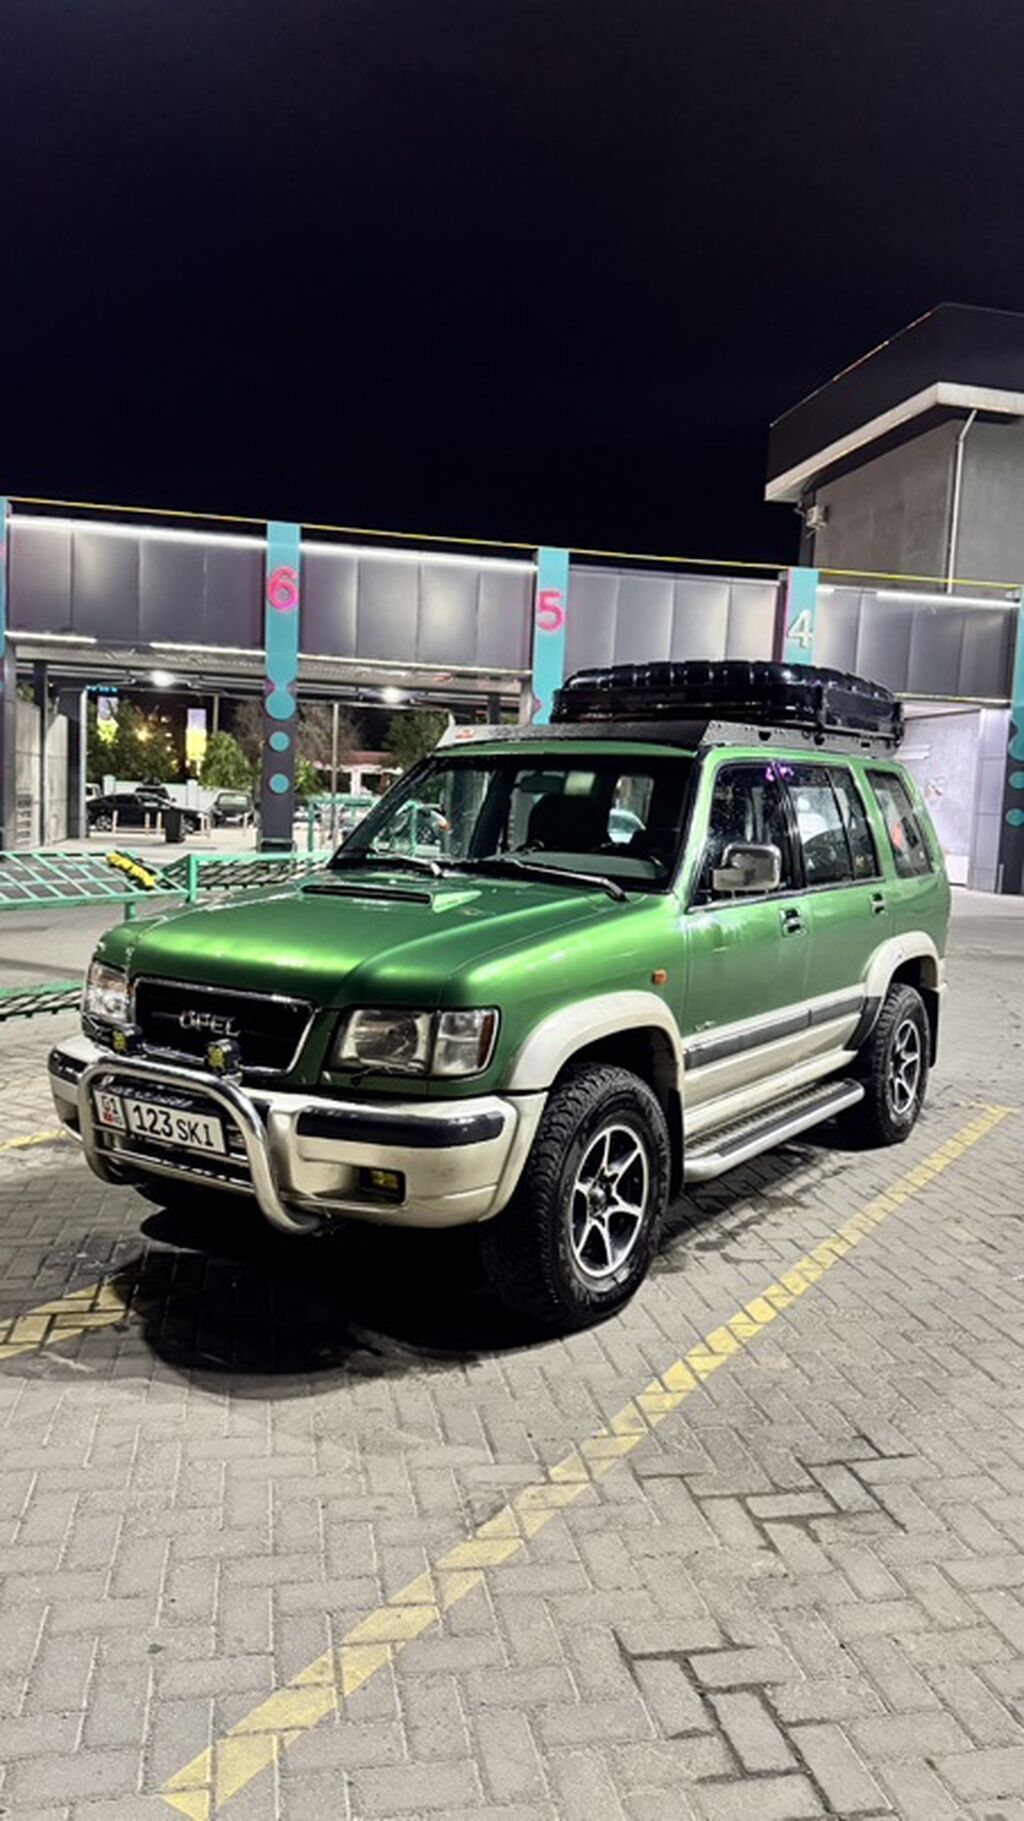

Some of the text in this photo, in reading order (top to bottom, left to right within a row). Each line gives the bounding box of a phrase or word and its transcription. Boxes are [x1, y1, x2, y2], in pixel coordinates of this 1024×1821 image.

[267, 565, 299, 612] 6
[536, 588, 566, 632] 5
[786, 609, 813, 649] 4
[179, 1010, 241, 1037] OPEL
[133, 1104, 173, 1138] 123
